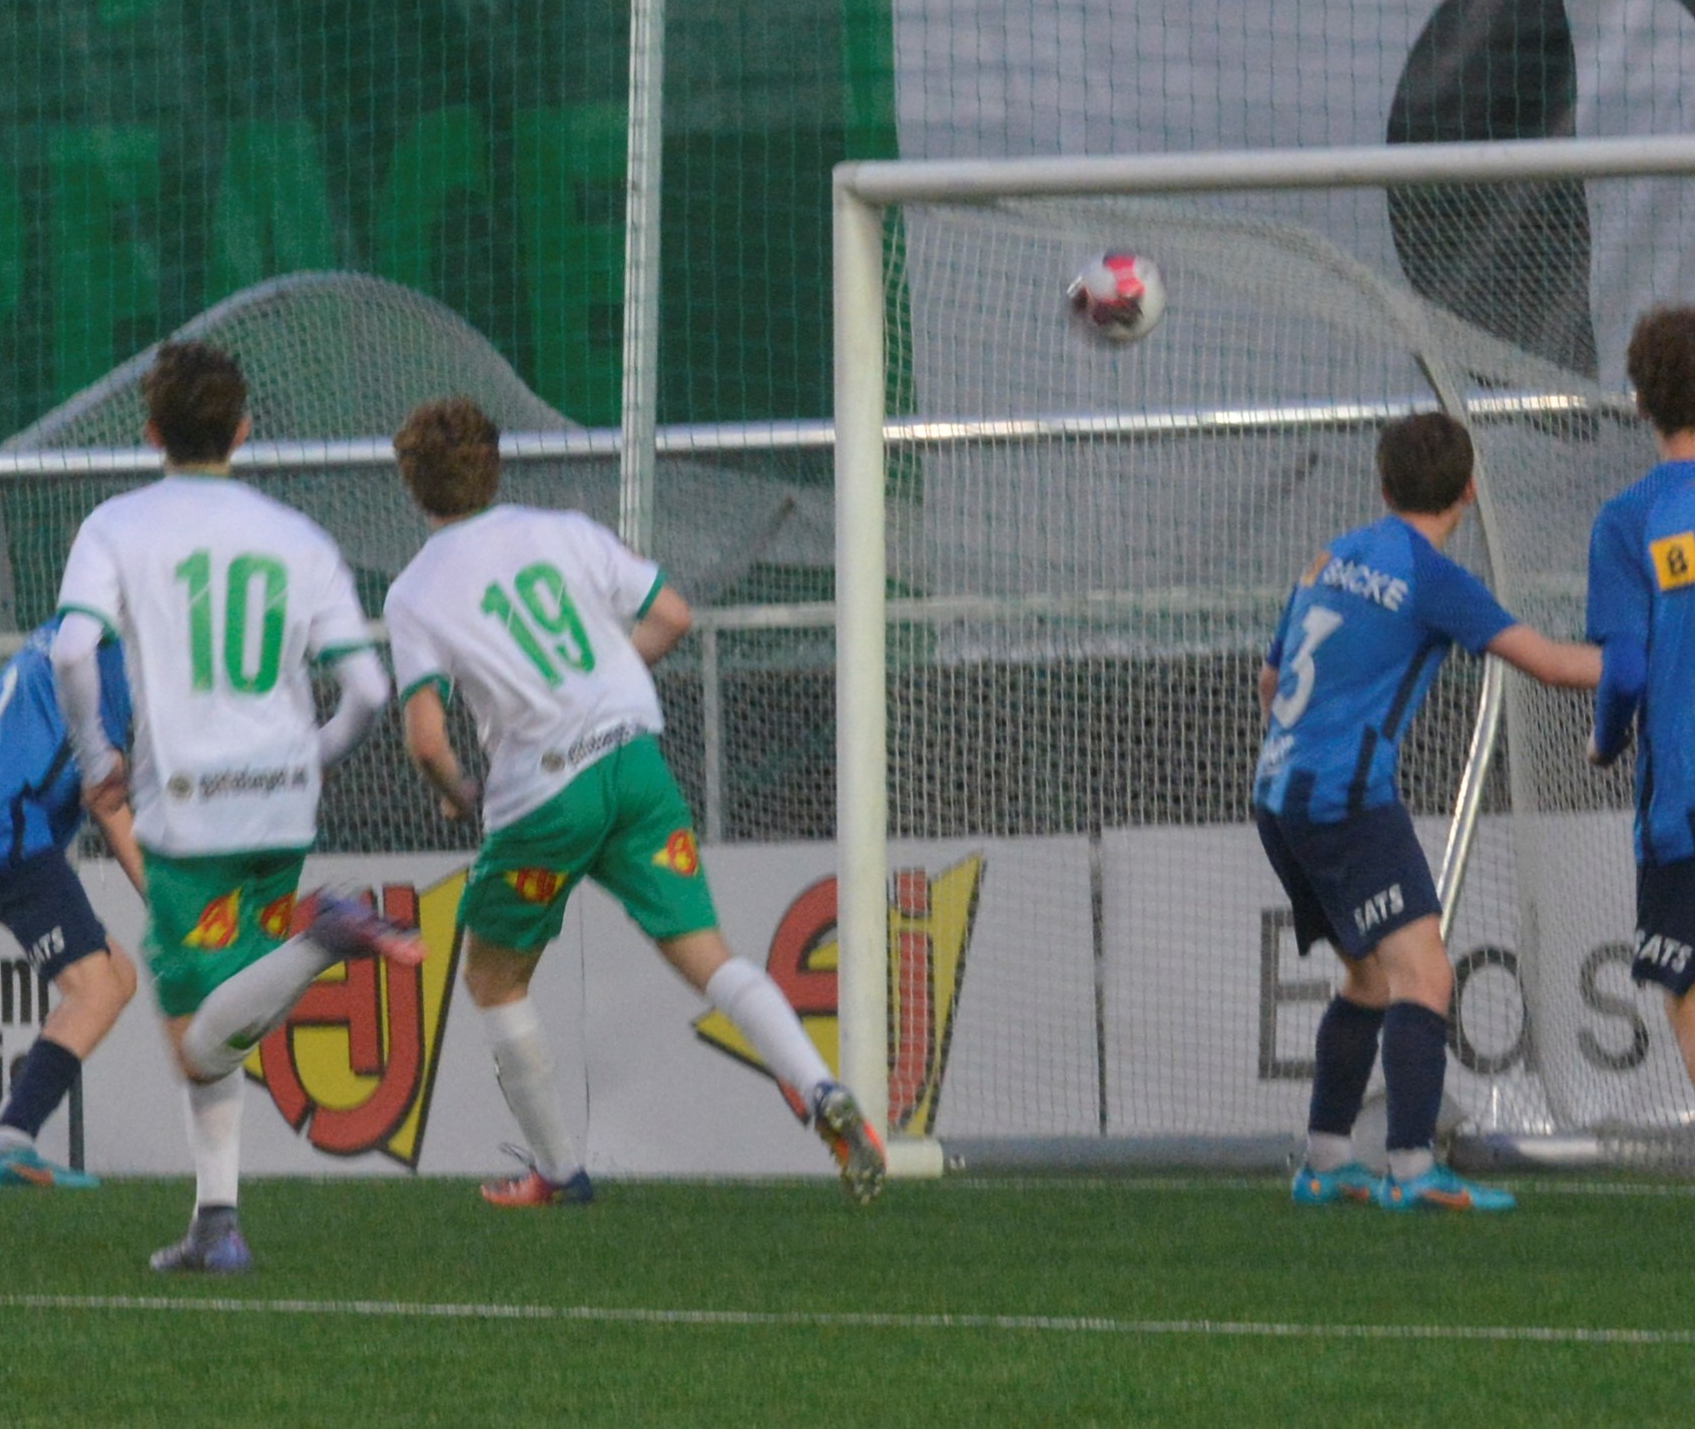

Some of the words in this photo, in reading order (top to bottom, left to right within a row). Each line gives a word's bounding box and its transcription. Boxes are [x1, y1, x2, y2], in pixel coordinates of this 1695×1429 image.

[174, 550, 289, 696] 10
[479, 561, 596, 688] 19
[1271, 604, 1345, 729] 3
